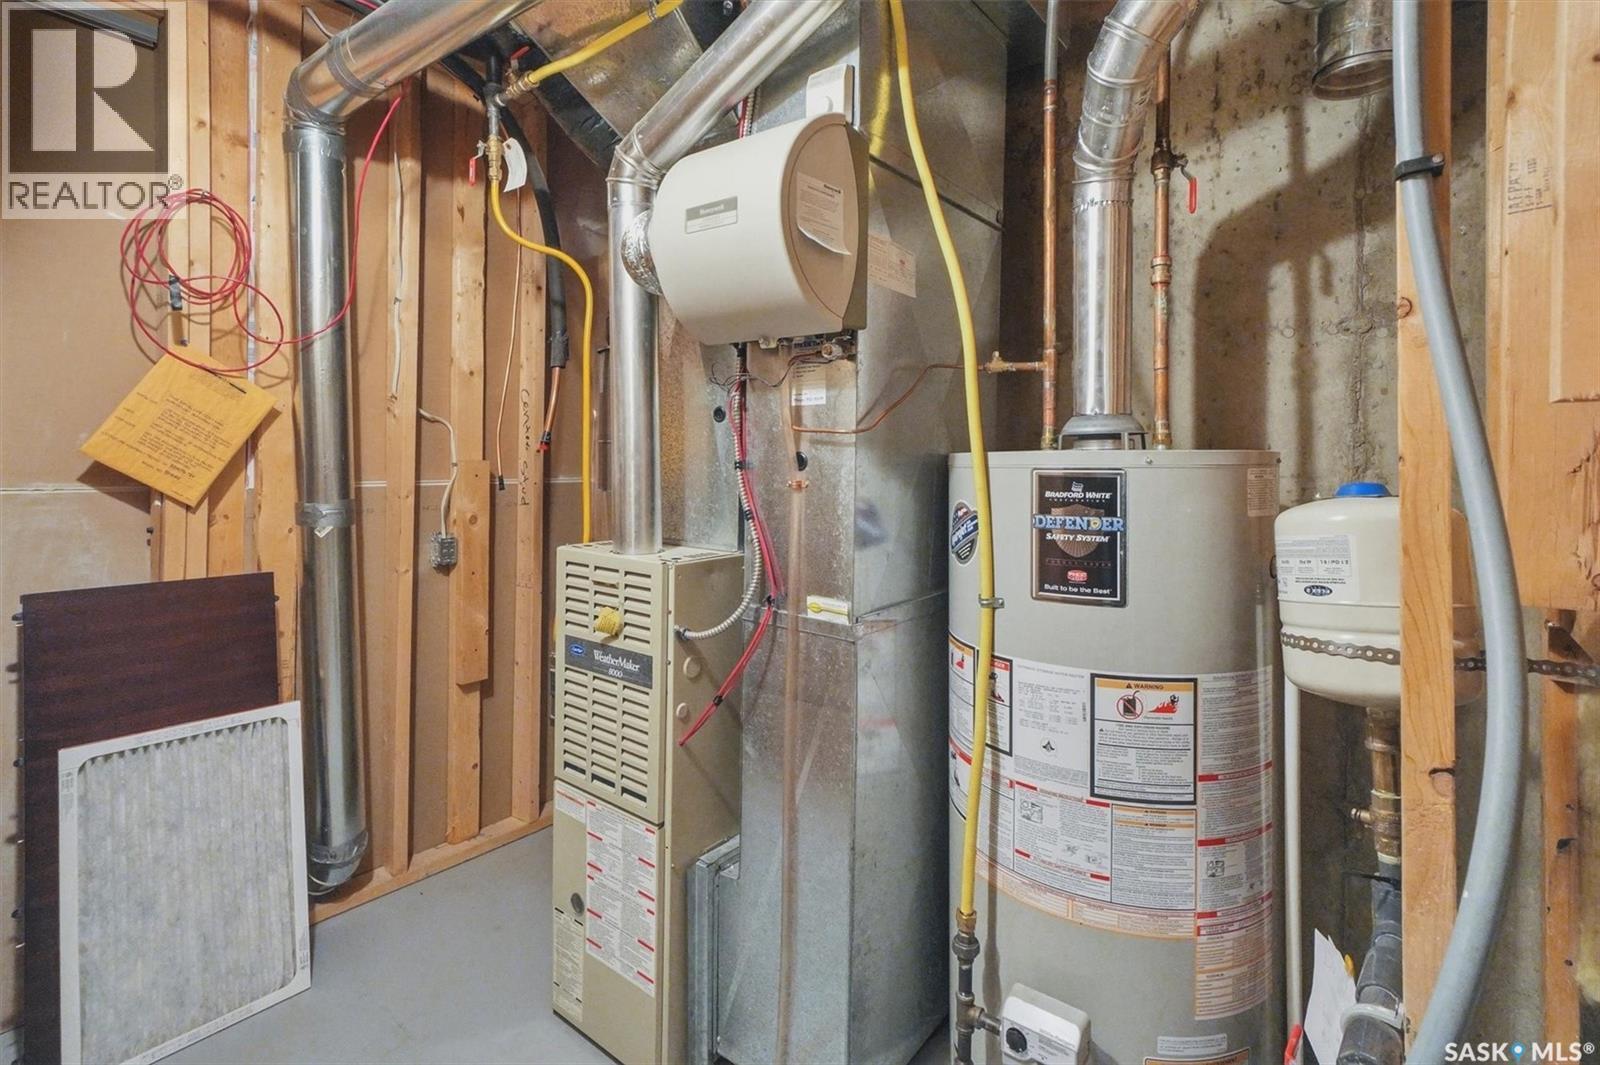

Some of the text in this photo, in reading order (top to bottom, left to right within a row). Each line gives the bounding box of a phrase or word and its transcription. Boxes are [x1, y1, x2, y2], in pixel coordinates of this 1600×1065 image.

[1044, 490, 1111, 499] BRADFORD WHITE
[1033, 515, 1124, 532] DEFENDER
[1045, 532, 1110, 543] SAFETY SYSTEM
[1043, 583, 1059, 591] Built
[1079, 586, 1092, 594] the
[594, 649, 640, 672] WeatherMaker
[1133, 682, 1164, 690] WARNING
